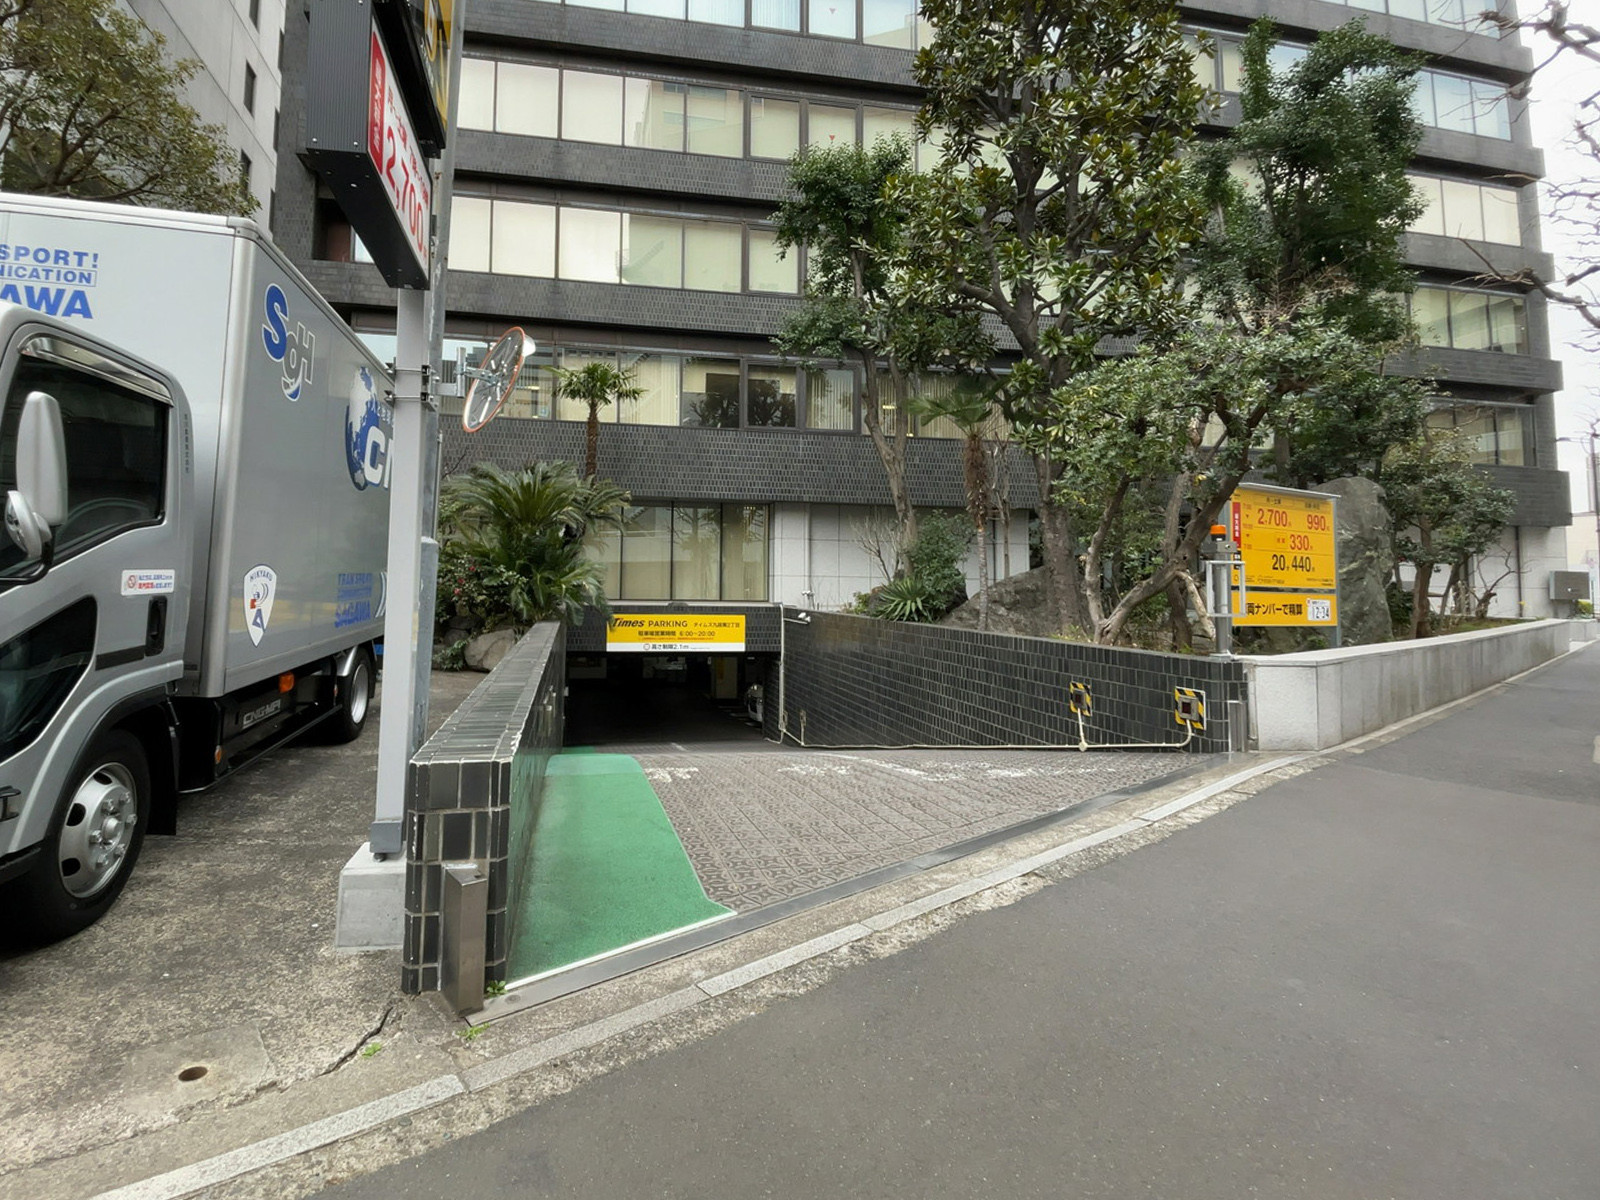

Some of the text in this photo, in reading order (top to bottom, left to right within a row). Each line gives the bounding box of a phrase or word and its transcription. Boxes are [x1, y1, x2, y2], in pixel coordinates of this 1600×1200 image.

[0, 244, 98, 268] SPORT!
[612, 617, 688, 628] Times PARKING
